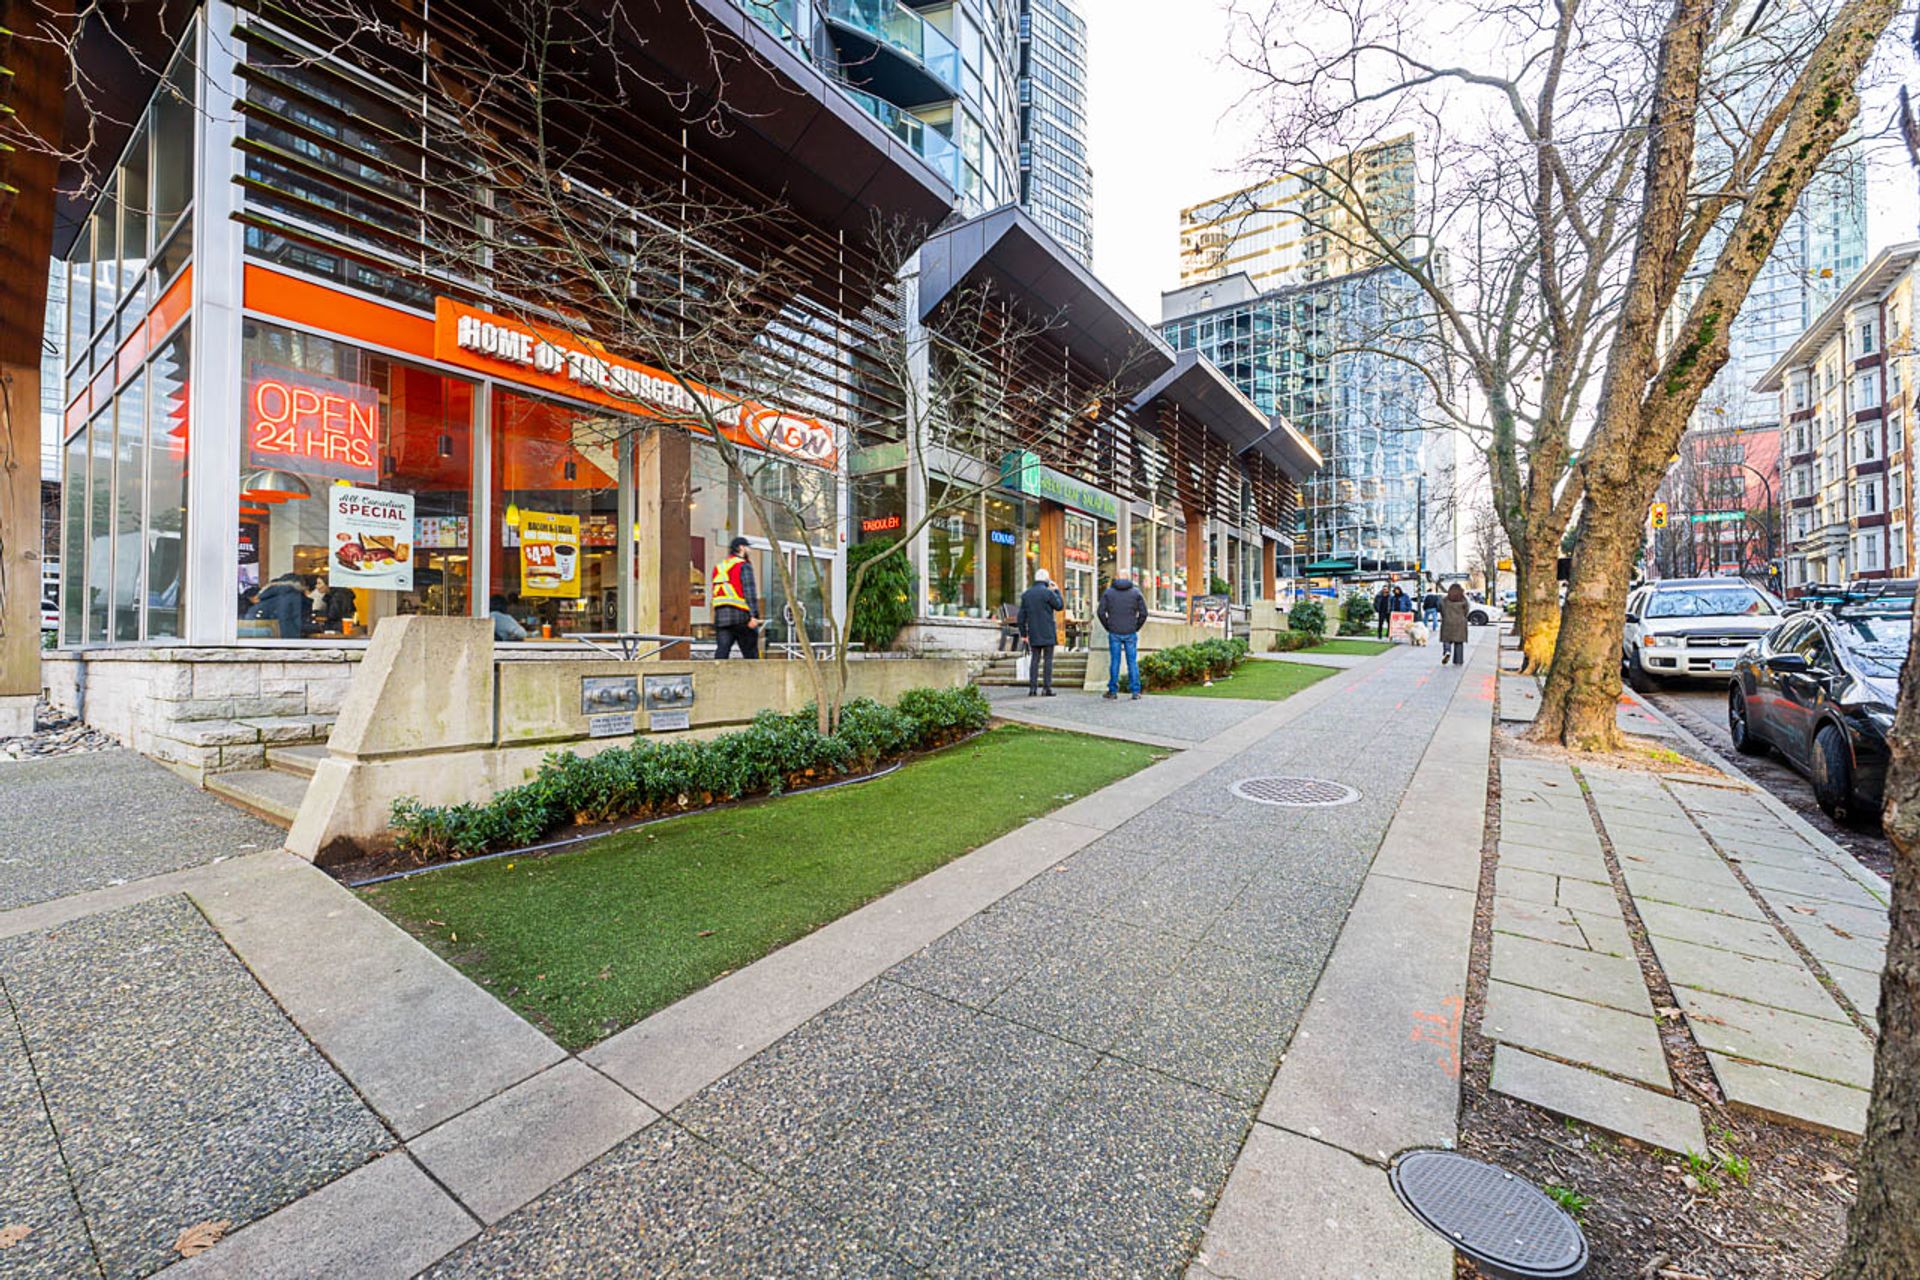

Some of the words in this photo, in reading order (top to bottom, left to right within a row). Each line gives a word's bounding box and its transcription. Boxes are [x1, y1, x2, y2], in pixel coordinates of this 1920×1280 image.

[457, 314, 534, 366] HOME
[534, 342, 567, 374] OF
[566, 349, 610, 387] THE
[610, 364, 685, 409] BURGER
[256, 382, 374, 440] OPEN
[255, 421, 299, 453] 24
[306, 429, 373, 466] HRS.
[764, 424, 827, 455] A&W
[338, 502, 406, 521] SPECIAL
